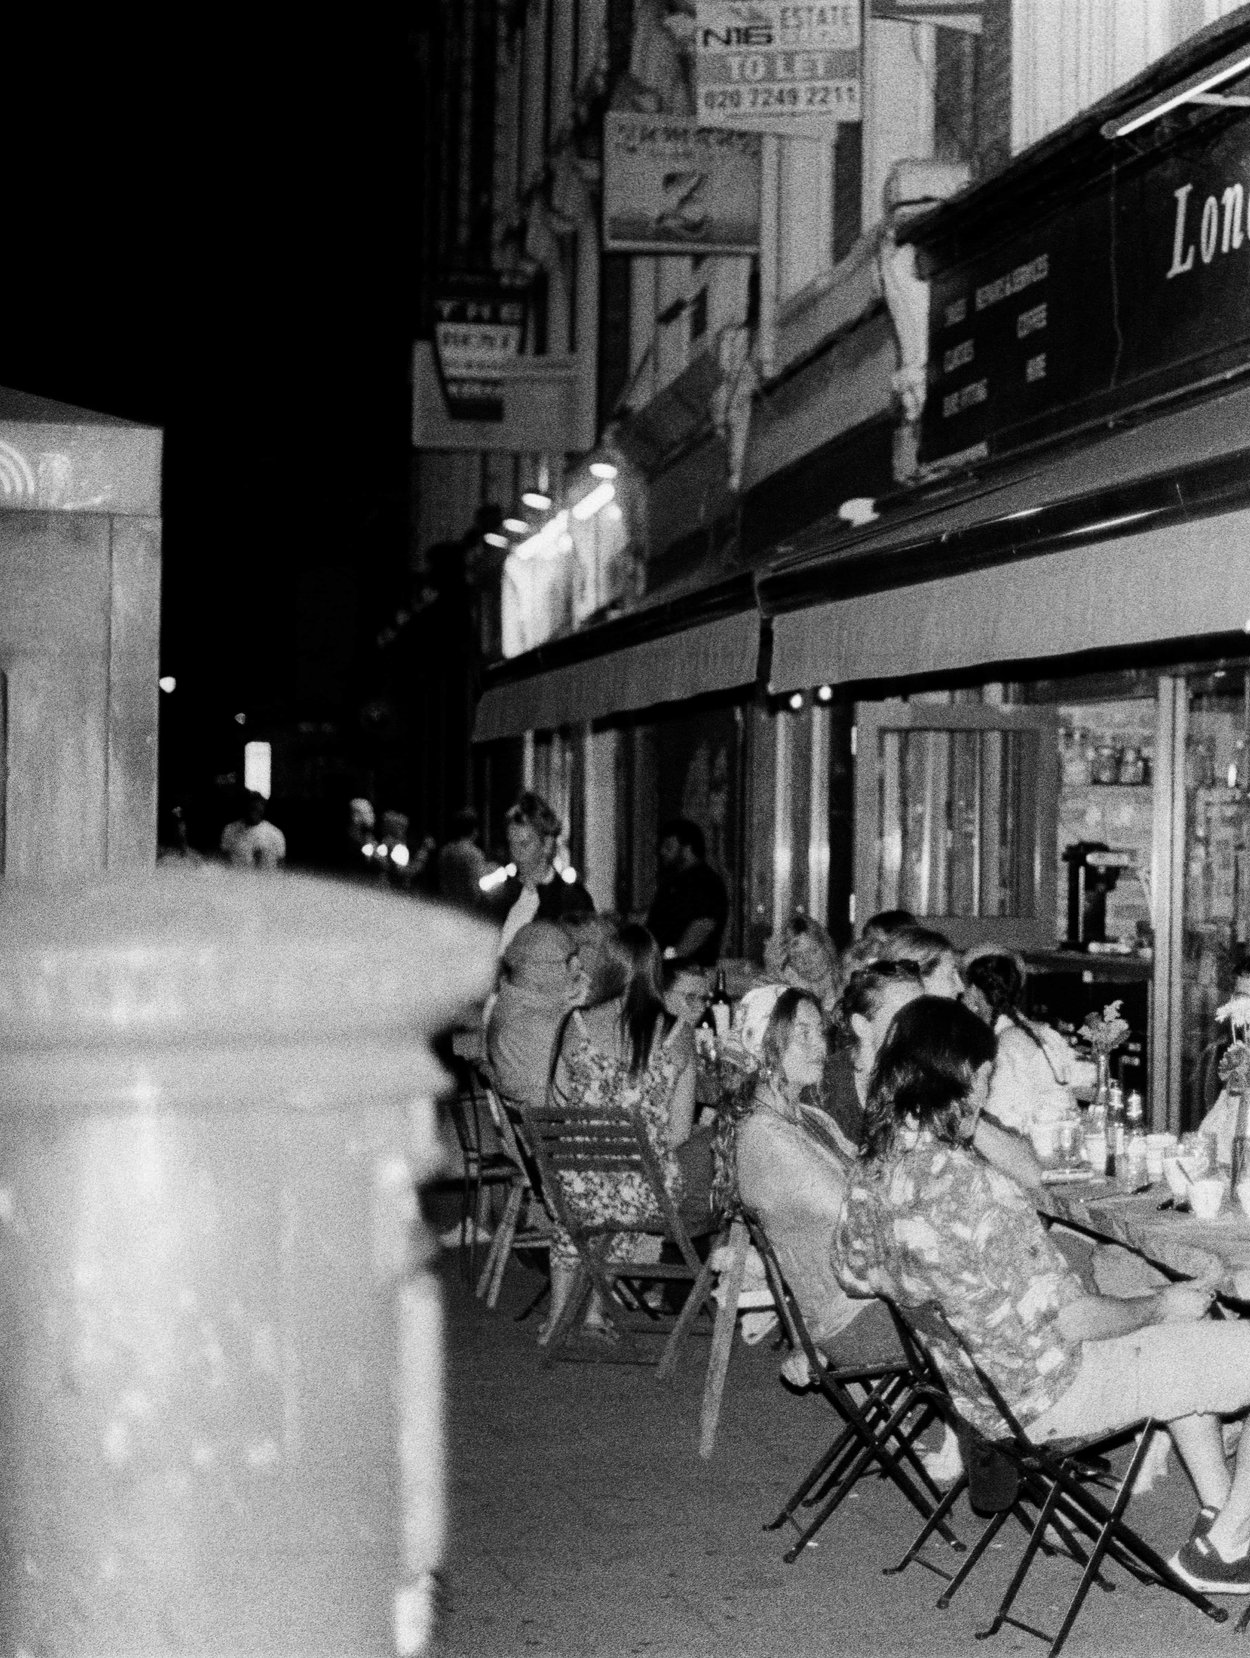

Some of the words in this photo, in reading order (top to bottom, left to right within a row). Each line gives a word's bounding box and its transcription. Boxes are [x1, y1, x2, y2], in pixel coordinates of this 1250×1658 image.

[780, 6, 852, 29] ESTATE
[702, 25, 774, 47] N16
[726, 54, 766, 82] TO
[775, 52, 832, 80] LET
[704, 88, 742, 110] 020
